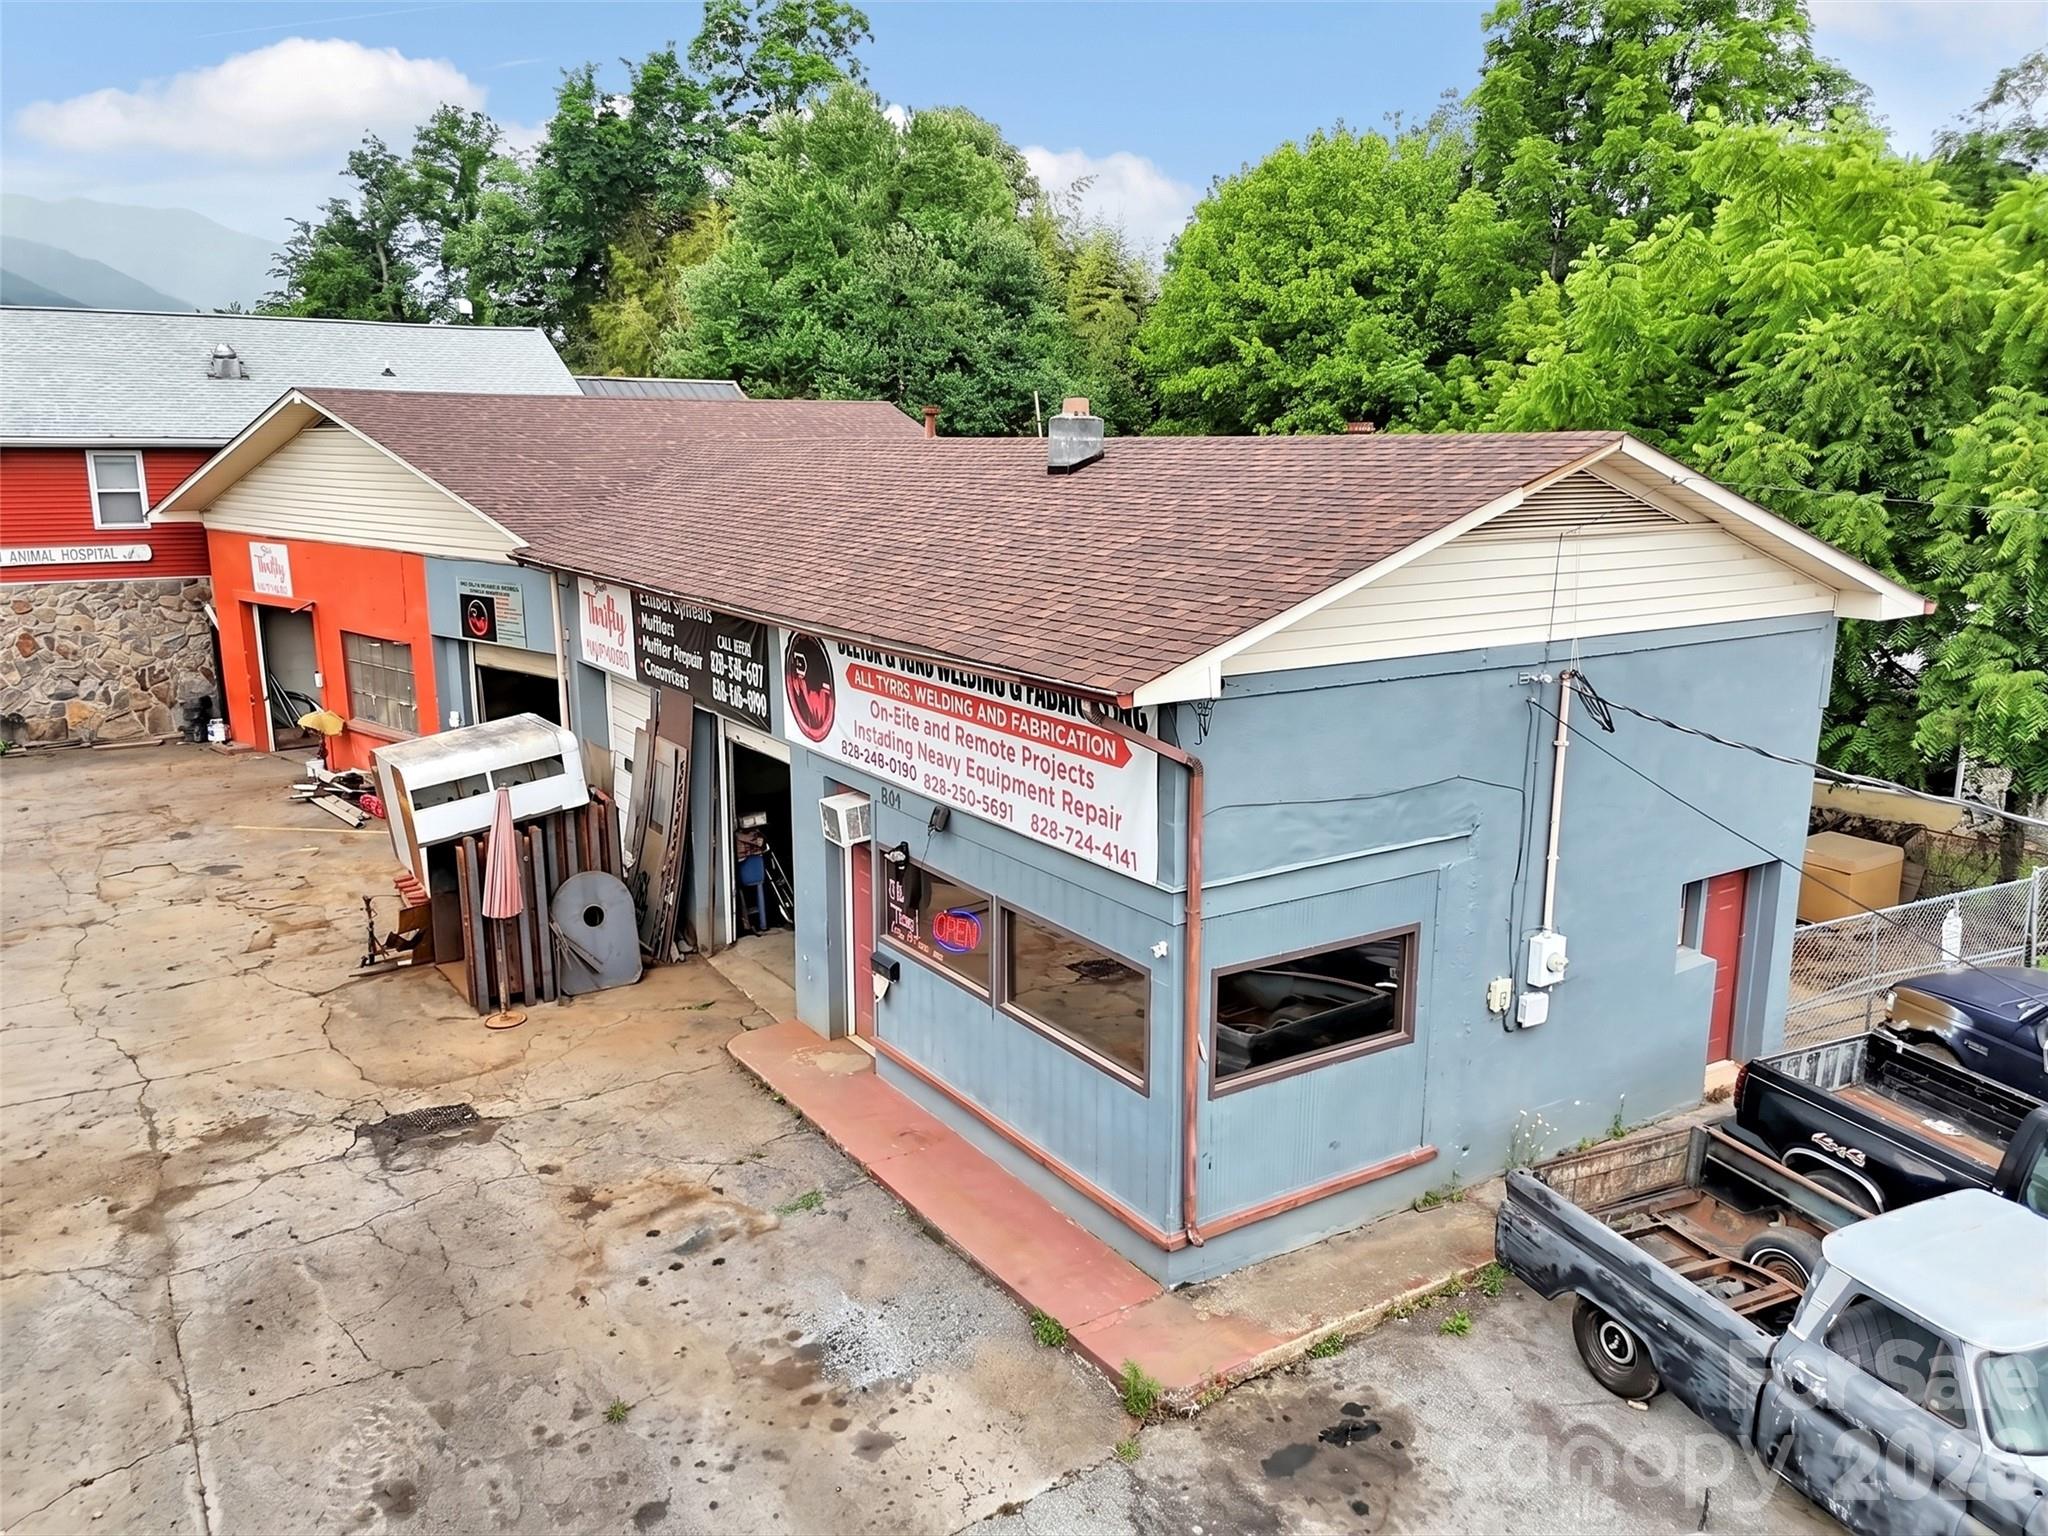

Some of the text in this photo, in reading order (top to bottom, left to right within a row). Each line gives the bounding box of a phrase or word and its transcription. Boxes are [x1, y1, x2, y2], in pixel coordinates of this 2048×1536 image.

[10, 550, 56, 562] ANIMAL
[61, 548, 118, 561] HOSPITAL
[854, 669, 875, 689] ALL
[914, 684, 974, 718] WELDING
[977, 703, 1007, 727] AND
[1011, 712, 1116, 760] FABRICATION
[924, 719, 950, 742] and
[955, 725, 1016, 763] Remote
[1022, 745, 1095, 790] Projects
[923, 773, 1013, 822] 828-250-5691
[1030, 813, 1137, 872] 828-724-4141
[966, 757, 1055, 808] Equipment
[1062, 789, 1122, 831] Repair
[933, 912, 978, 949] OPEN
